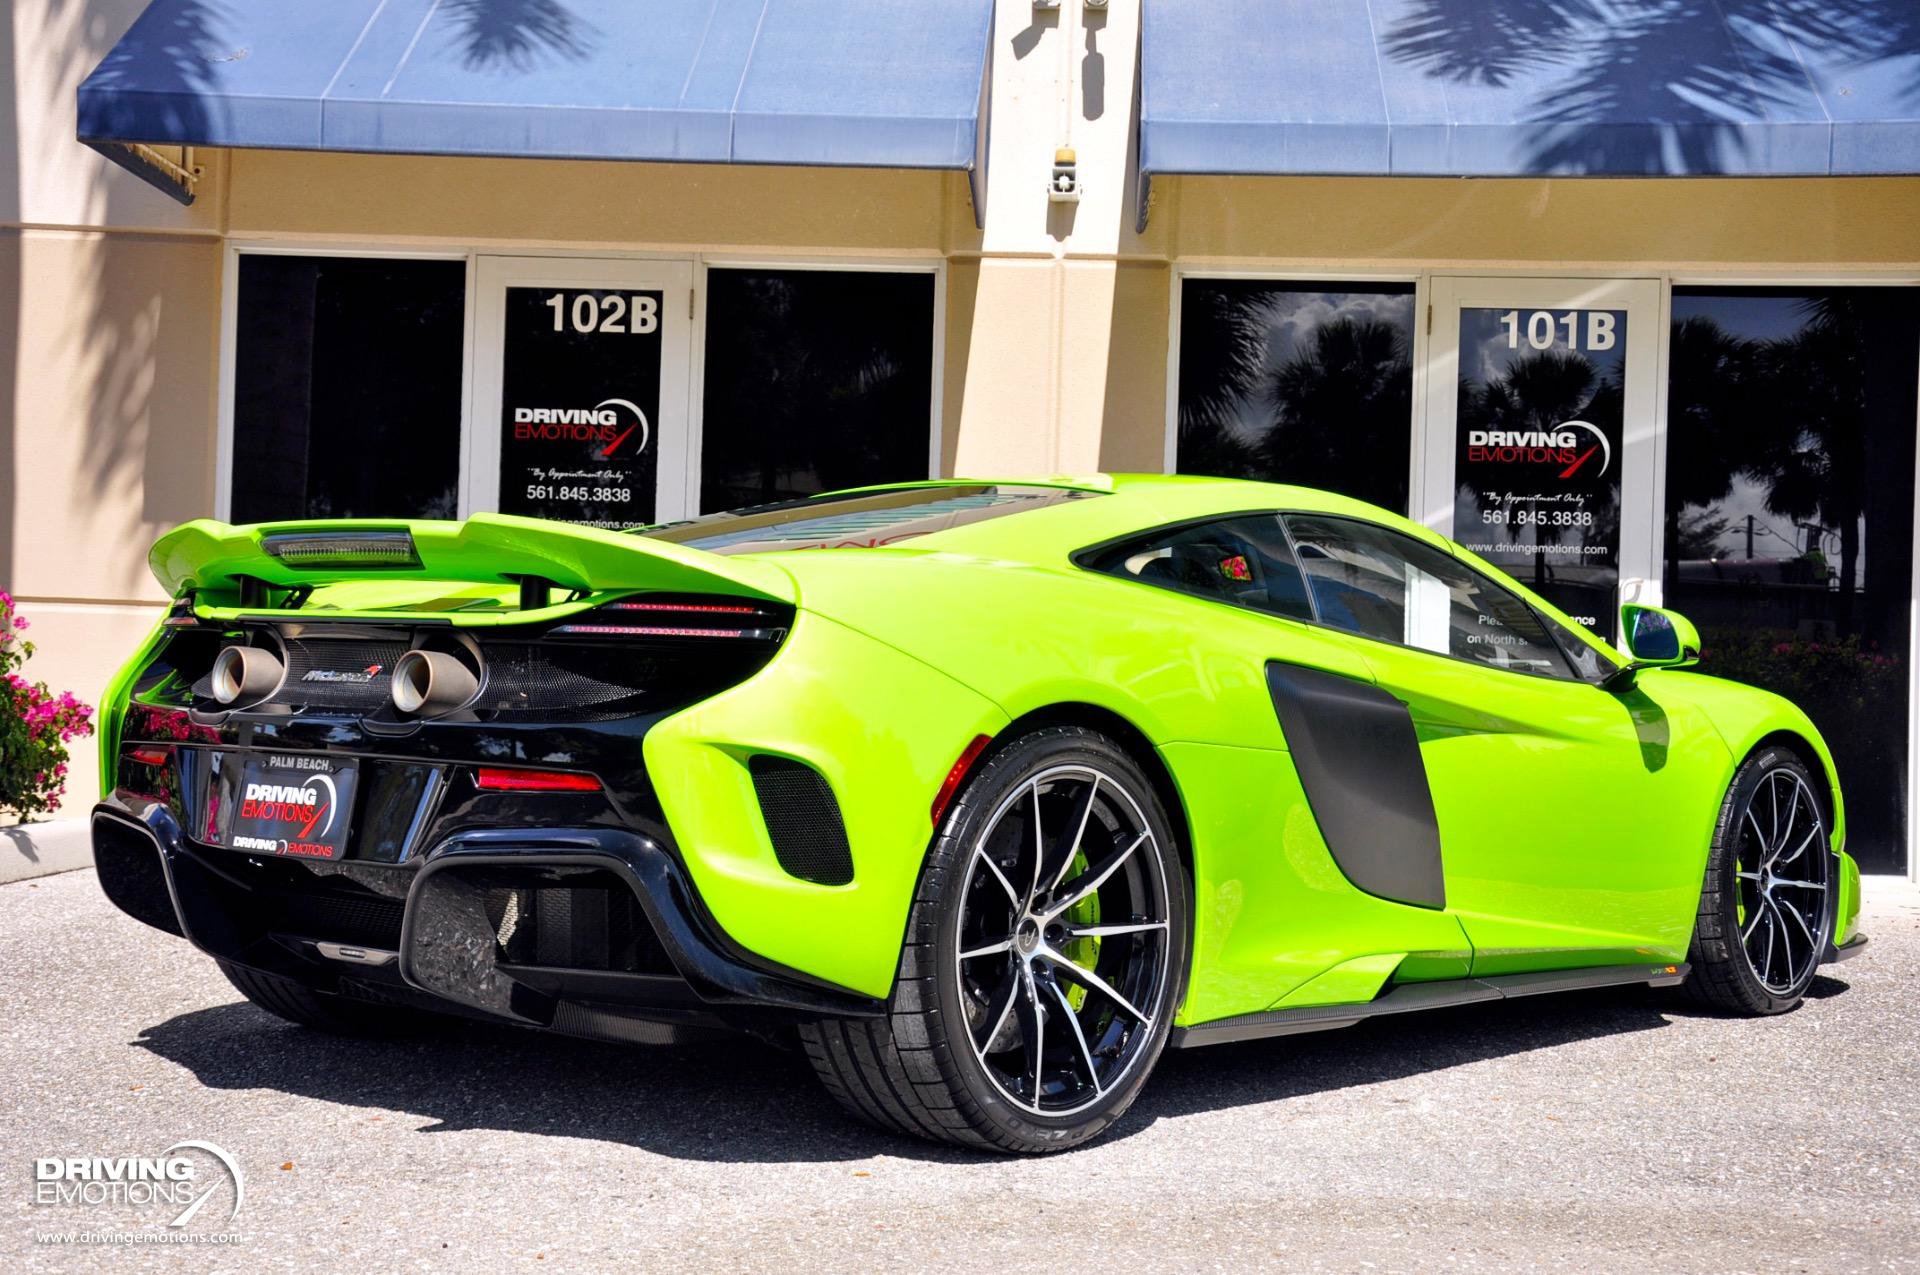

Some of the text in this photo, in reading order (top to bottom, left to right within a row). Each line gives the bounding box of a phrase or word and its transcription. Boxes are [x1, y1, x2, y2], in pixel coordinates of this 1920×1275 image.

[546, 293, 658, 334] 102B
[1500, 310, 1616, 351] 101B
[514, 408, 617, 425] DRIVING
[514, 424, 617, 441] EMOTIONS
[1469, 430, 1577, 448] DRIVING
[1468, 447, 1577, 464] EMOTIONS
[548, 468, 601, 480] Appointment
[526, 485, 631, 502] 561.845.3838
[1504, 492, 1562, 504] Appointment
[1482, 510, 1592, 526] 561.845.3838
[1466, 543, 1608, 555] www.drivingemotions.com
[1467, 635, 1481, 644] on
[1484, 634, 1516, 645] North
[270, 756, 330, 771] PALM BEACH
[245, 783, 317, 806] DRIVING
[241, 800, 316, 823] EMOTIONS
[233, 836, 333, 857] DRIVING EMOTIONS
